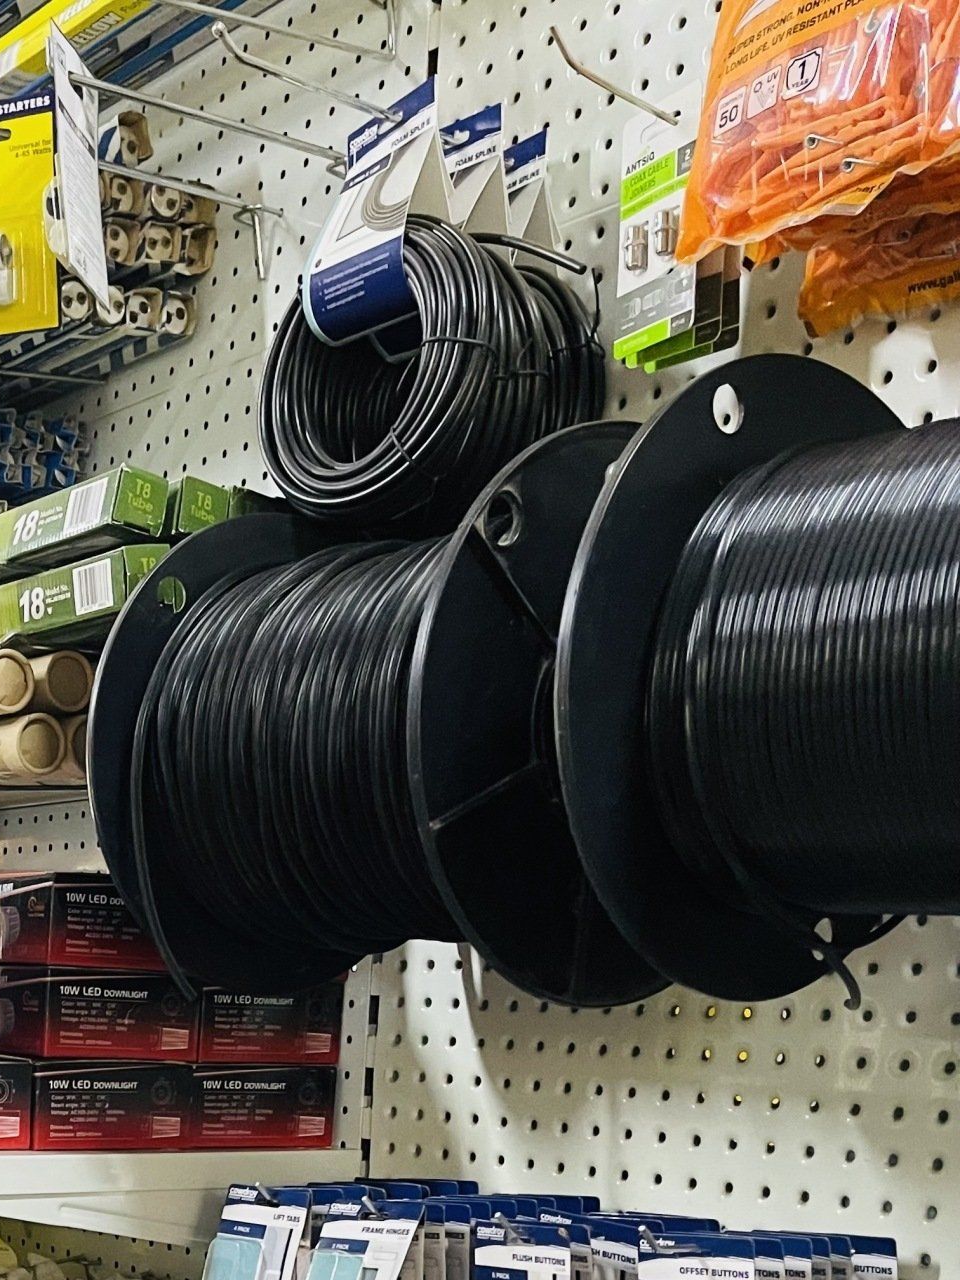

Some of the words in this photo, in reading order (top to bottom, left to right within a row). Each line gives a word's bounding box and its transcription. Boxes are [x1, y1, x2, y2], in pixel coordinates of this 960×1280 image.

[726, 56, 750, 75] LONG
[772, 31, 786, 46] UV
[787, 4, 842, 35] RESISTANT
[797, 59, 807, 80] 1
[719, 105, 738, 128] 50
[455, 153, 474, 168] FOAM
[475, 145, 497, 162] SPLINE
[626, 152, 655, 176] ANTSIG
[136, 478, 152, 500] T8
[127, 491, 154, 513] Tube
[196, 491, 212, 508] T8
[190, 504, 215, 522] Tube
[13, 509, 40, 546] 18
[19, 587, 45, 623] 18
[66, 892, 86, 903] 10W
[88, 894, 107, 905] LED
[59, 986, 80, 995] 10W
[82, 986, 102, 997] LED
[104, 989, 148, 999] DOWNLIGHT
[214, 995, 232, 1004] 10W
[234, 995, 252, 1005] LED
[49, 1080, 69, 1090] 10W
[72, 1080, 91, 1089] LED
[93, 1081, 138, 1090] DOWNLIGHT
[202, 1080, 222, 1089] 10W
[224, 1081, 242, 1089] LED
[244, 1082, 286, 1090] DOWNLIGHT
[273, 1213, 284, 1222] LIFT
[286, 1215, 301, 1223] TABS
[362, 1226, 385, 1235] FRAME
[386, 1227, 410, 1236] HINGES
[512, 1254, 533, 1262] FLUSH
[535, 1256, 566, 1266] BUTTONS
[602, 1250, 637, 1265] BUTTONS
[679, 1266, 710, 1277] OFFSET
[711, 1268, 750, 1279] BUTTONS
[854, 1264, 893, 1275] BUTTONS
